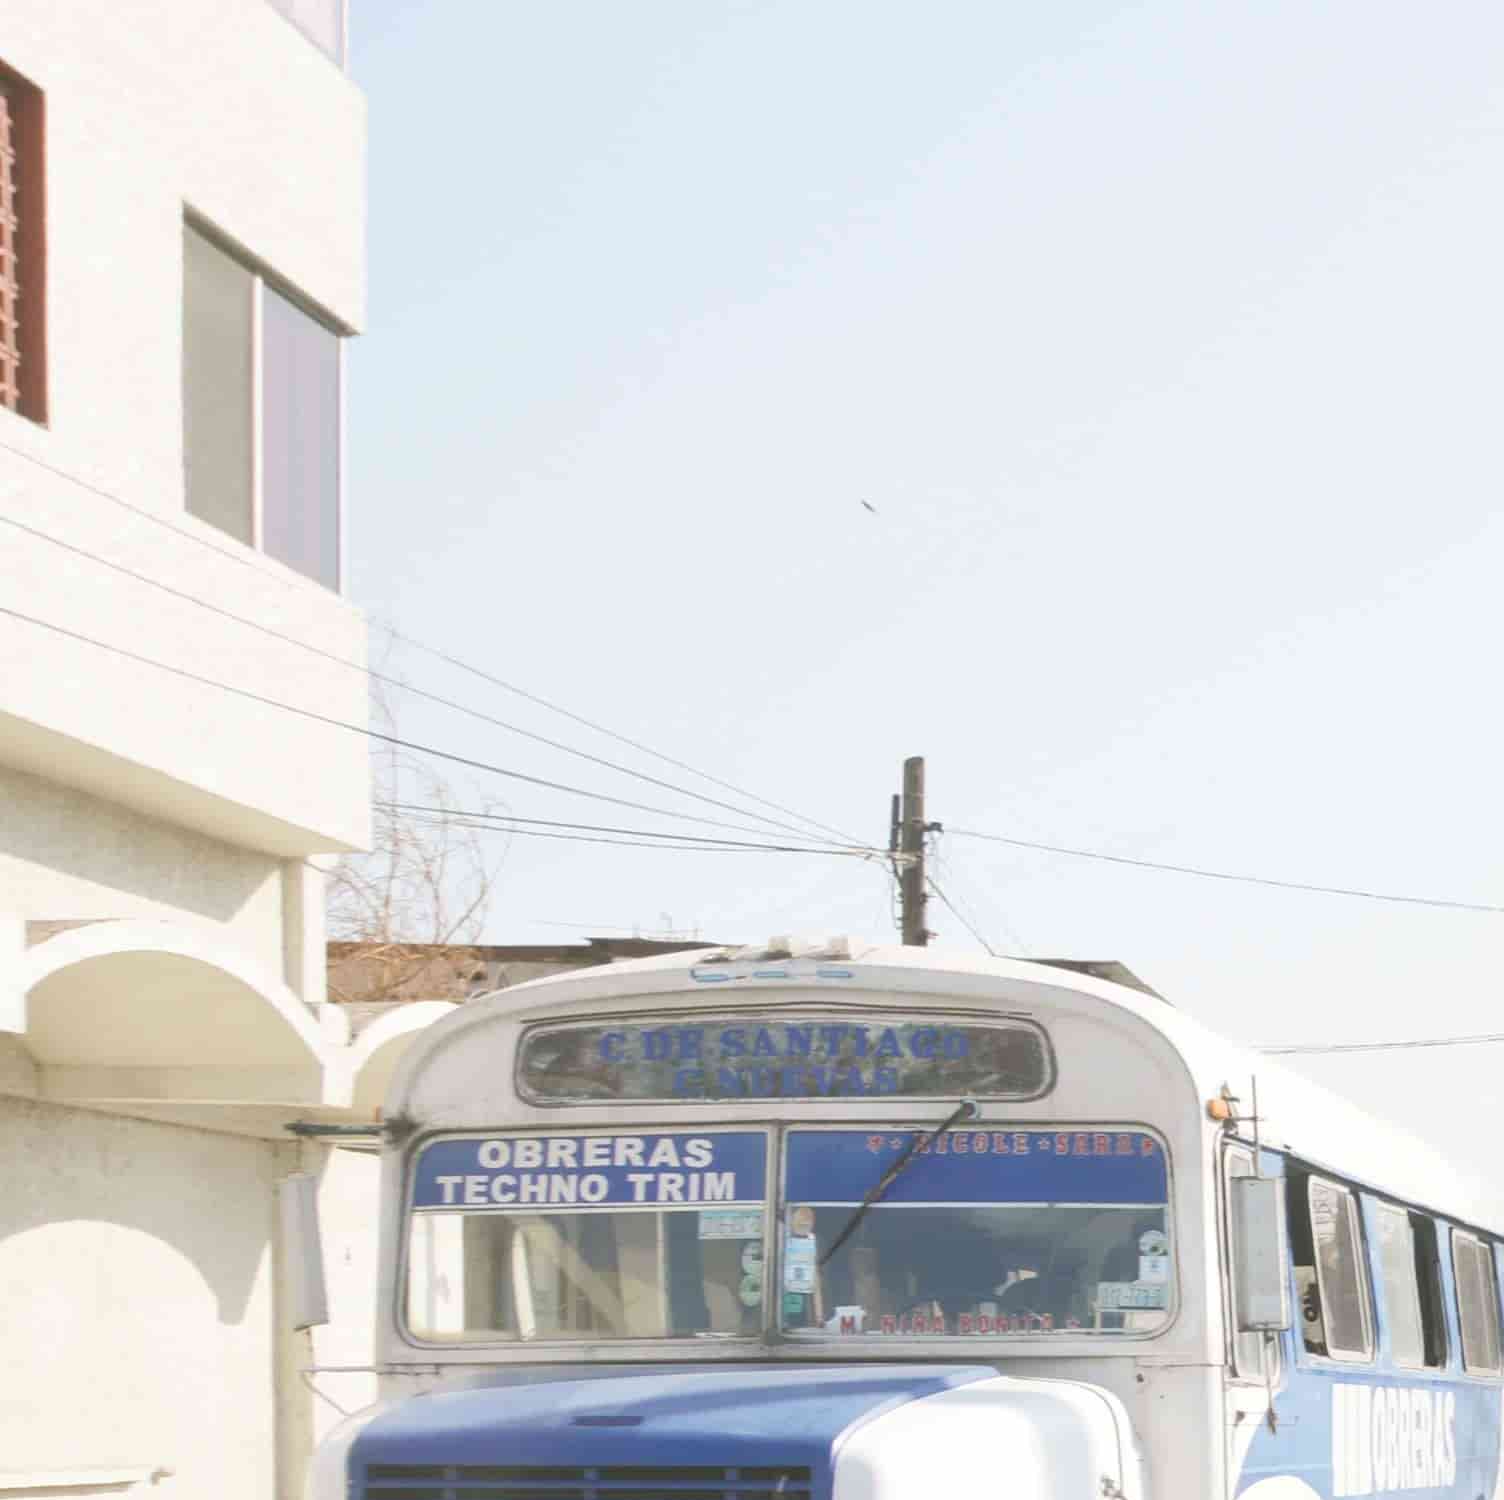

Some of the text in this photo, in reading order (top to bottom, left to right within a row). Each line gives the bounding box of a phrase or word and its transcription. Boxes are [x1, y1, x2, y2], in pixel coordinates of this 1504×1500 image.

[720, 1024, 970, 1062] SANTIAGO
[478, 1138, 714, 1168] OBRERAS
[436, 1172, 736, 1204] TECHNO TRIM
